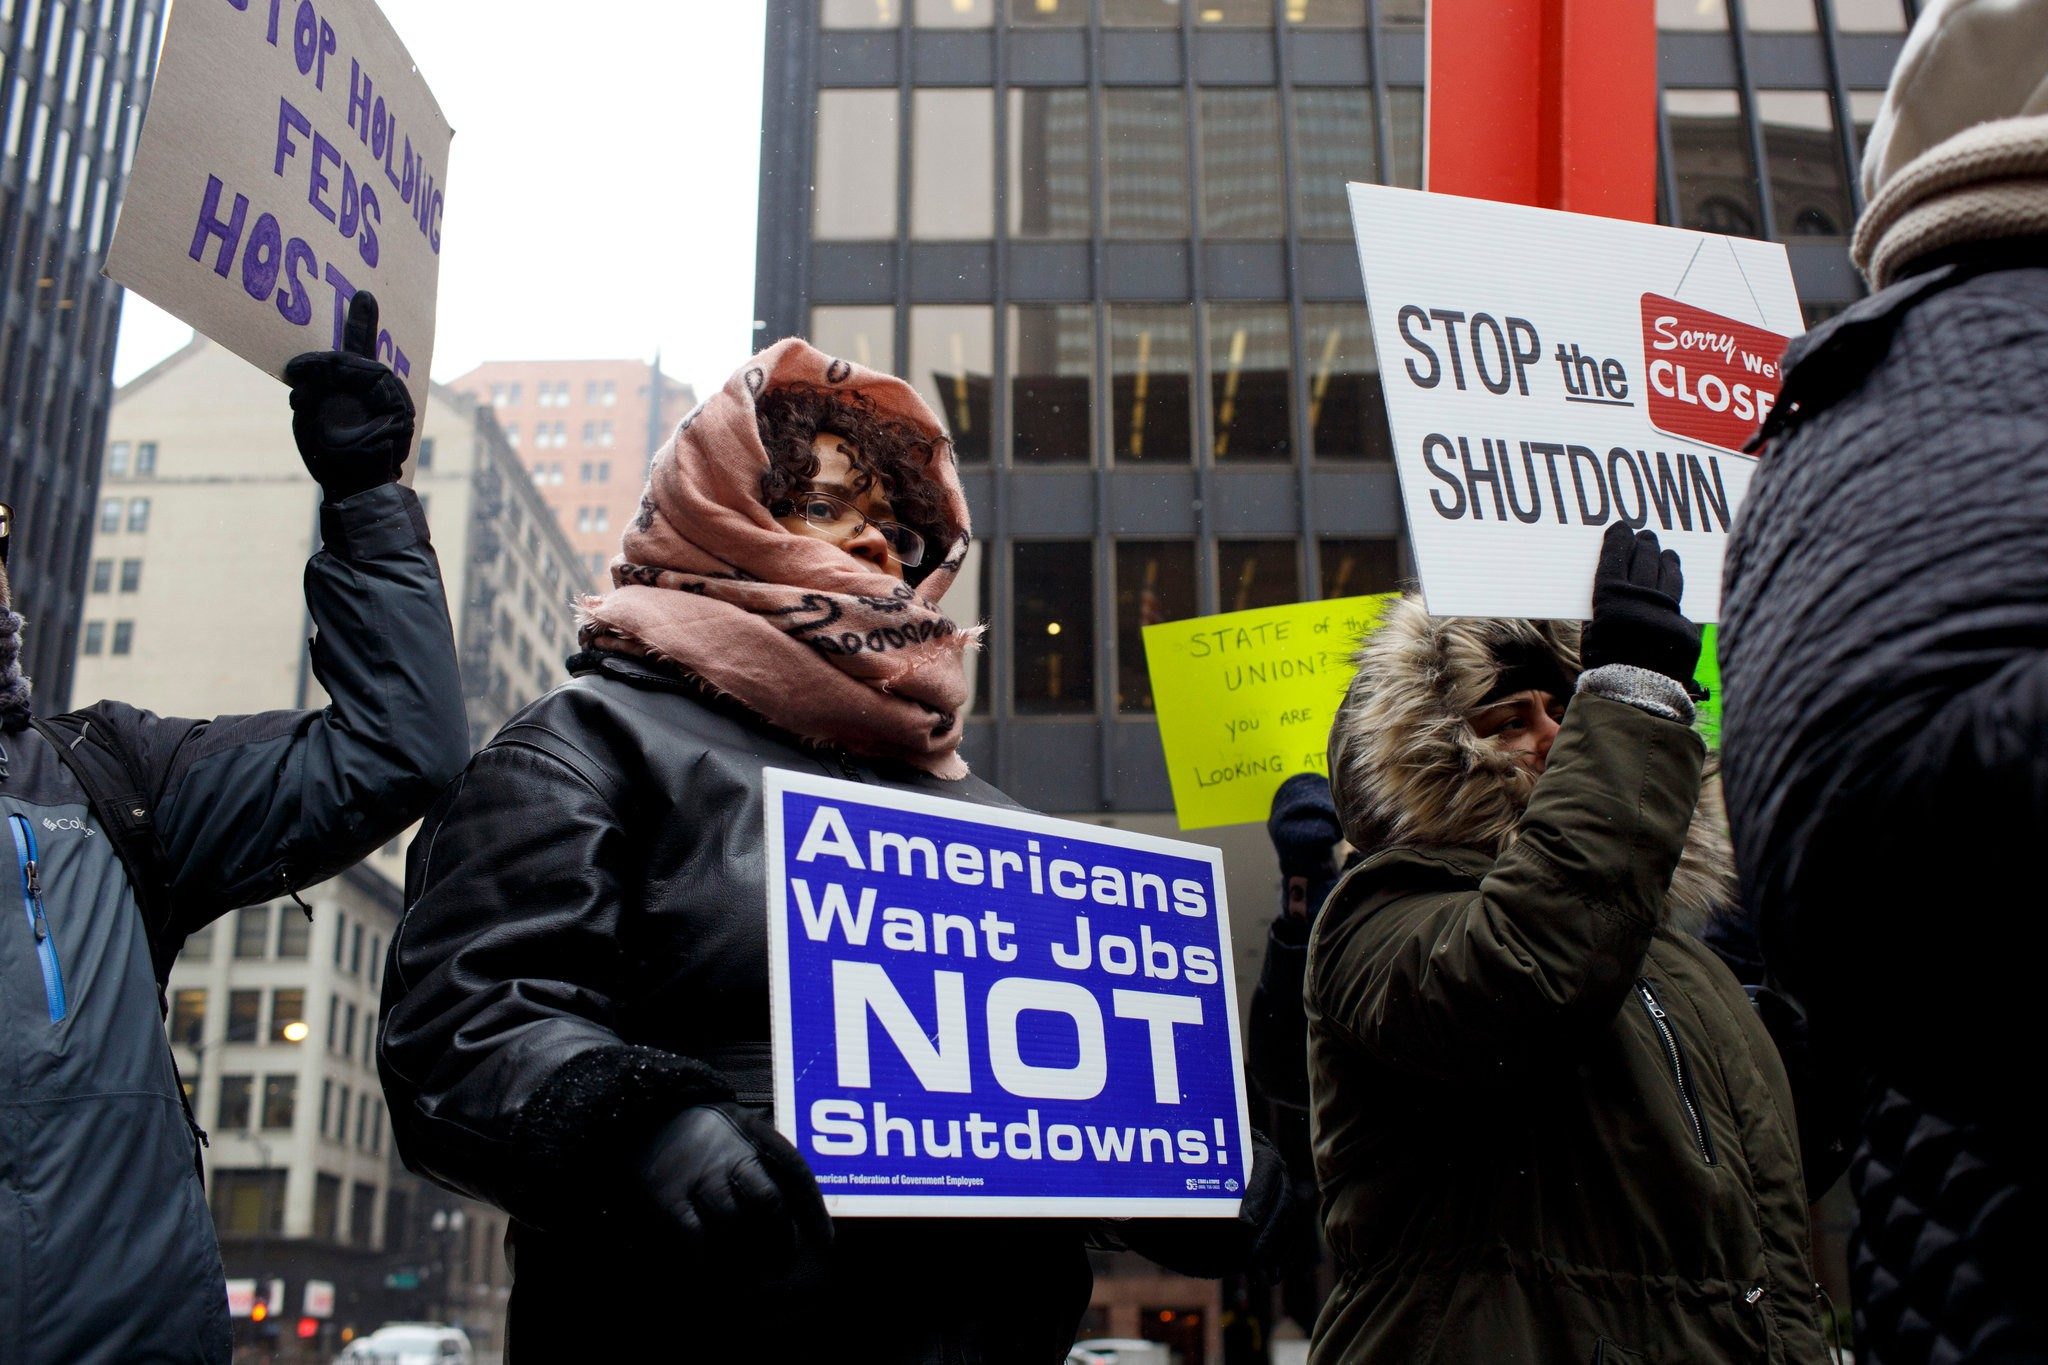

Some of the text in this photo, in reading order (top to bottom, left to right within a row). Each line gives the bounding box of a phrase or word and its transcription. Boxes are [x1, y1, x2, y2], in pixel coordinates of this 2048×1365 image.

[227, 0, 443, 255] TOP HOLDING
[274, 96, 381, 268] FEDS
[188, 173, 411, 379] HOST
[1398, 304, 1629, 401] STOP the
[1652, 315, 1783, 381] Sorry We'
[1649, 358, 1776, 425] CLOSE
[1422, 432, 1732, 534] SHUTDOWN
[1190, 616, 1371, 658] STATE of the
[1224, 651, 1328, 691] UNION?
[1280, 708, 1313, 727] ARE
[1194, 751, 1327, 788] LOOKING AT
[796, 804, 1208, 918] Americans
[791, 877, 1219, 985] Want Jobs
[832, 959, 1203, 1105] NOT
[810, 1098, 1228, 1165] Shutdowns!
[814, 1173, 984, 1188] merican Federation of Government Employees
